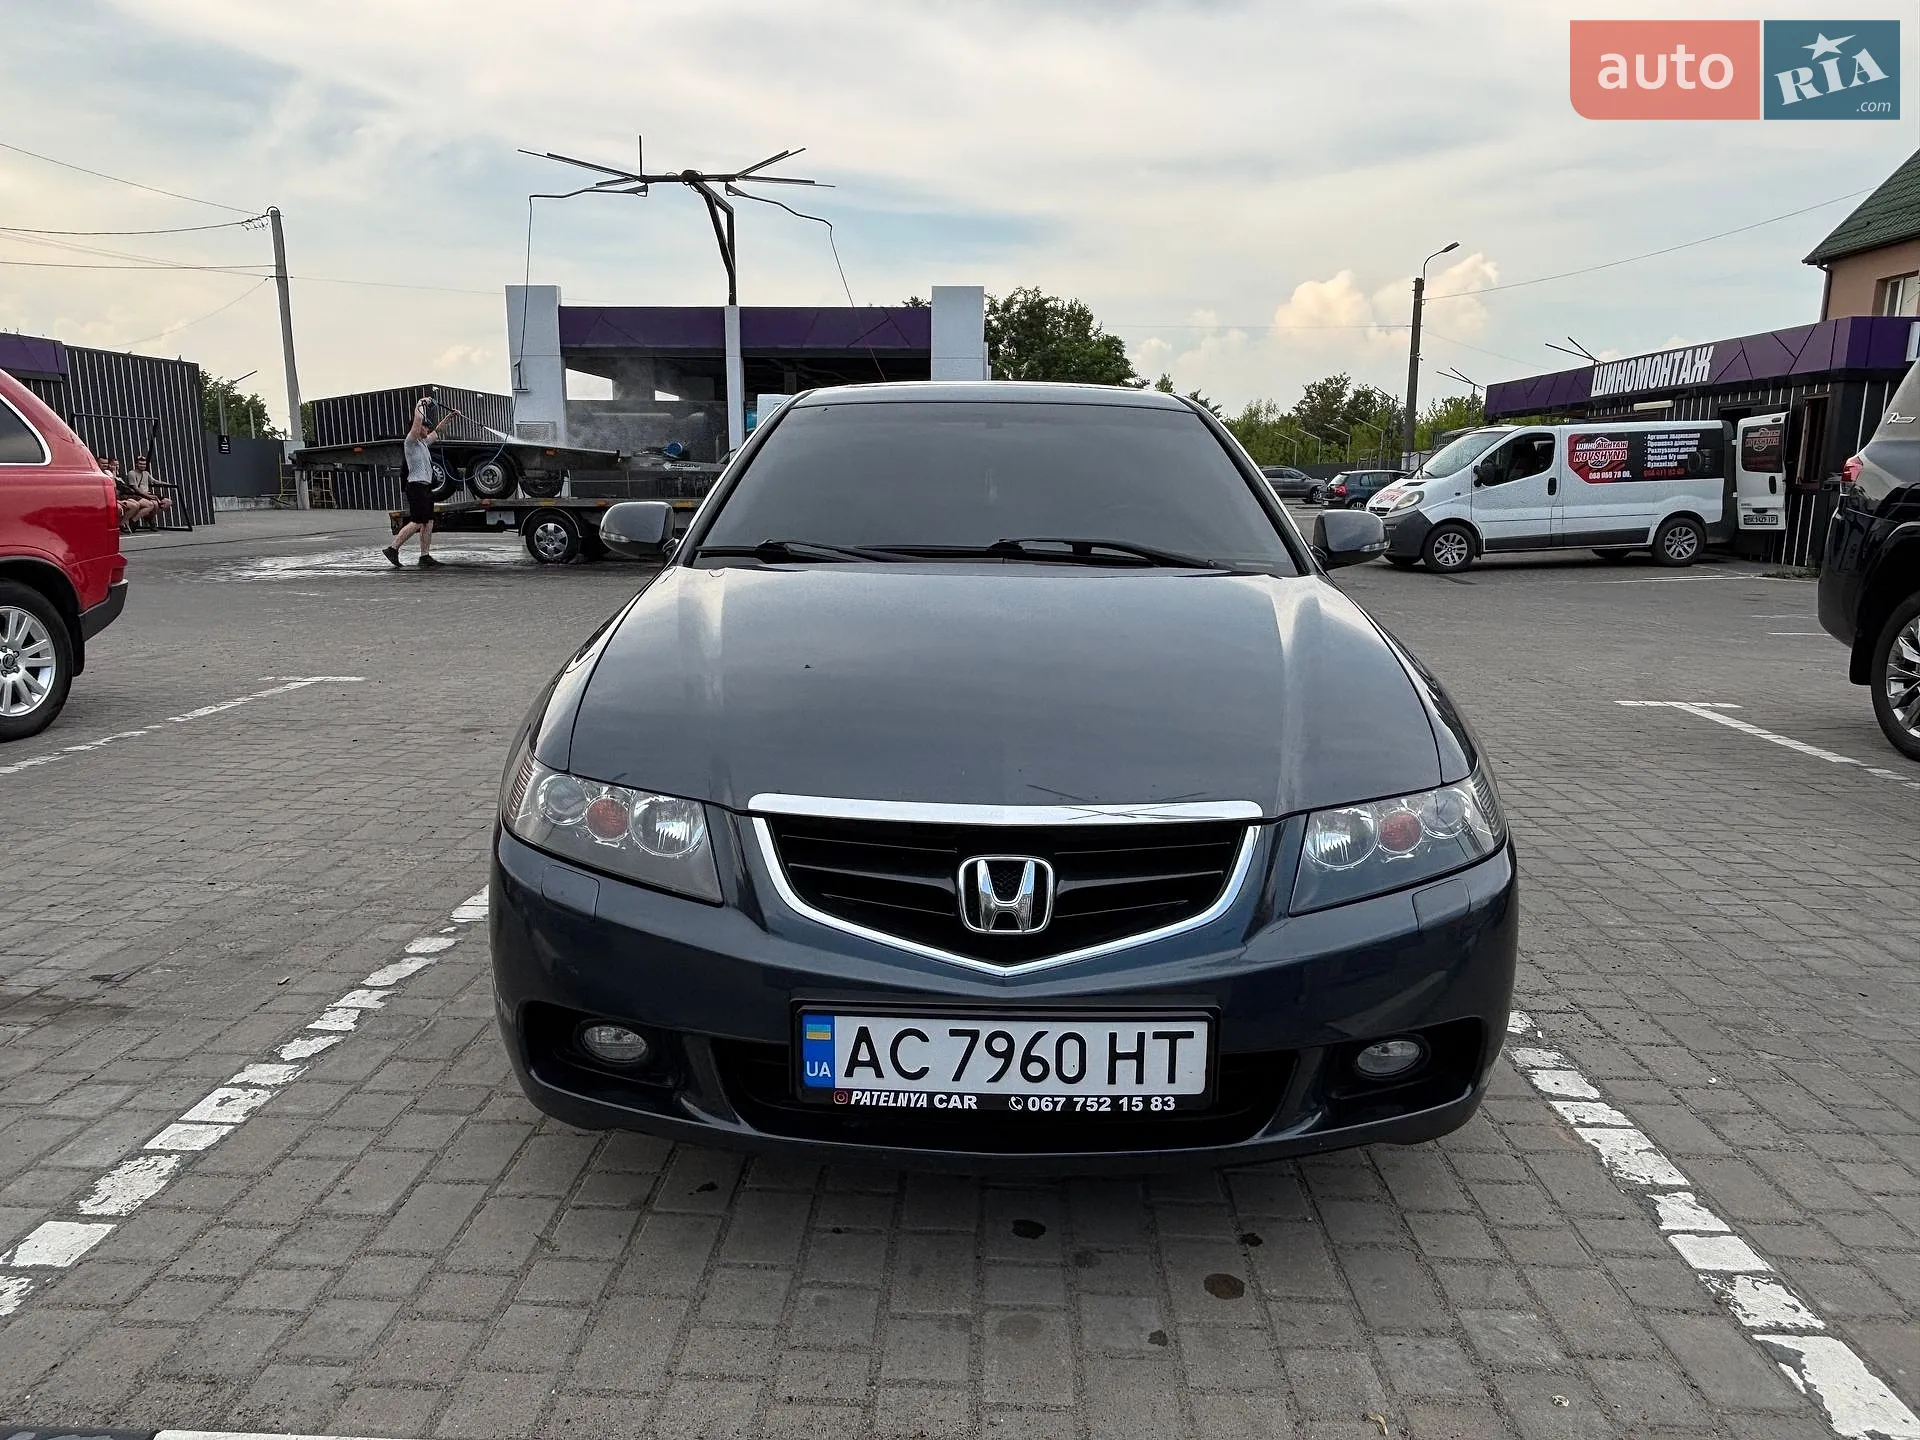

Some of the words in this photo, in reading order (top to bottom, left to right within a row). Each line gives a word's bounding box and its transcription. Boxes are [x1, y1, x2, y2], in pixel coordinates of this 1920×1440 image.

[1591, 345, 1714, 397] ШИНОМОНТАЖ
[844, 1026, 930, 1080] AC
[949, 1029, 1087, 1084] 7960
[1107, 1031, 1195, 1085] HT
[806, 1061, 832, 1077] UA
[850, 1091, 928, 1108] PATELNYA
[933, 1095, 978, 1109] CAR
[1027, 1097, 1066, 1112] 067
[1073, 1097, 1111, 1112] 752
[1119, 1097, 1143, 1112] 15
[1150, 1097, 1176, 1112] 83
